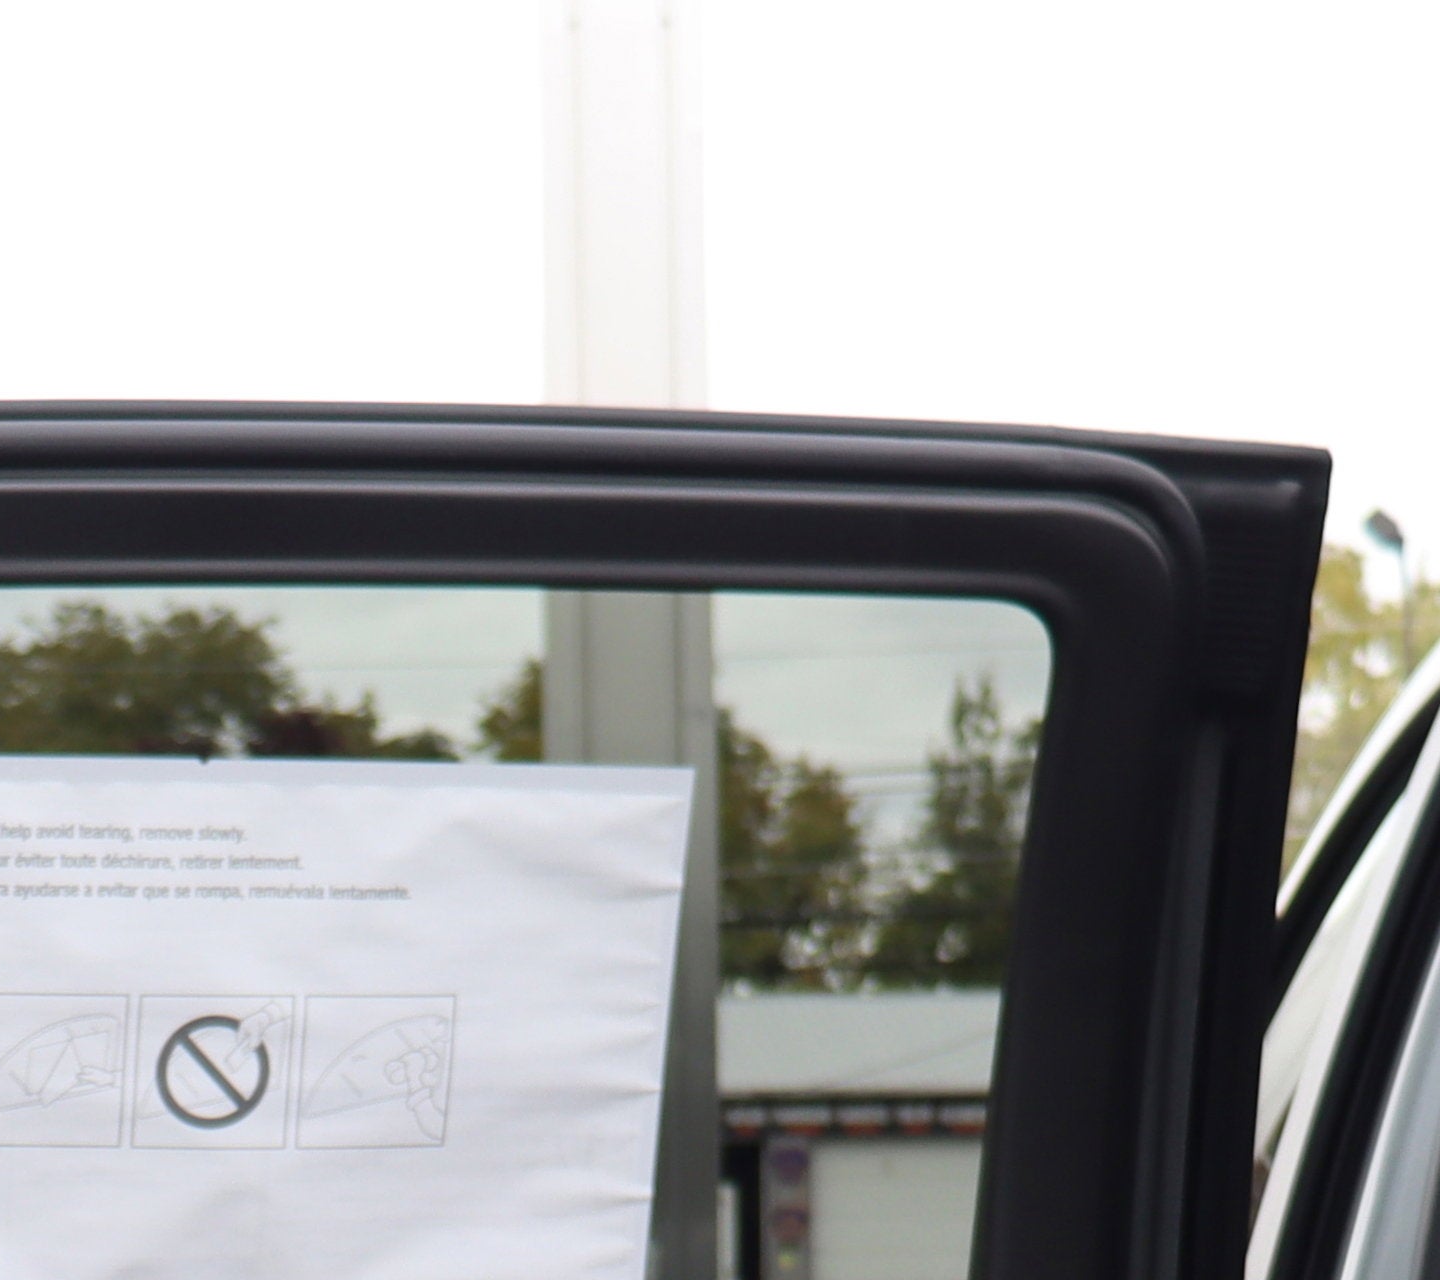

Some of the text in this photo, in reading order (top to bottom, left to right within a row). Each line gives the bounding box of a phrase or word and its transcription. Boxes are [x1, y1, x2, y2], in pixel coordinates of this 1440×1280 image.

[0, 823, 32, 841] help
[36, 824, 74, 839] avoid
[78, 825, 134, 843] tearing,
[139, 827, 193, 840] remove
[198, 826, 247, 843] slowly.
[15, 853, 54, 868] éviter
[60, 854, 96, 868] toute
[101, 854, 175, 870] déchirure,
[180, 855, 224, 869] retirer
[228, 856, 303, 870] lentement.
[13, 881, 78, 899] ayudarse
[83, 885, 93, 897] a
[97, 882, 138, 898] evitar
[142, 886, 169, 901] que
[174, 886, 191, 898] se
[195, 886, 244, 900] rompa,
[249, 884, 324, 899] remuévala
[328, 885, 411, 900] lentamente.
